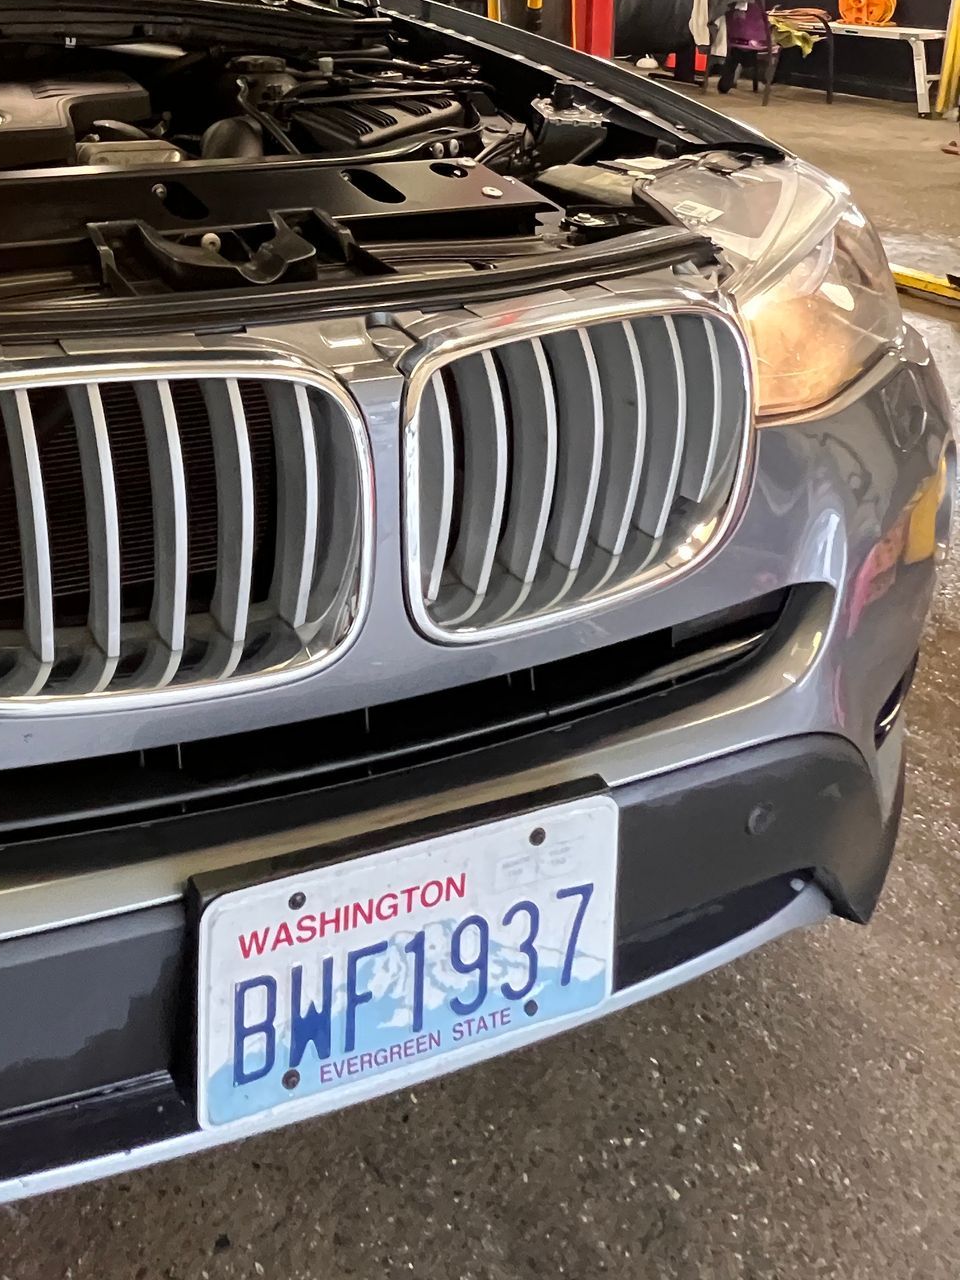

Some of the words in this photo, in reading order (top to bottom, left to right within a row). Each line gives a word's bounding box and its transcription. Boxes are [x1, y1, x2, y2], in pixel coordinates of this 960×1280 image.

[238, 873, 466, 959] WASHINGTON
[233, 883, 594, 1087] BWF1937
[320, 1030, 441, 1083] EVERGREEN
[452, 1008, 512, 1041] STATE
